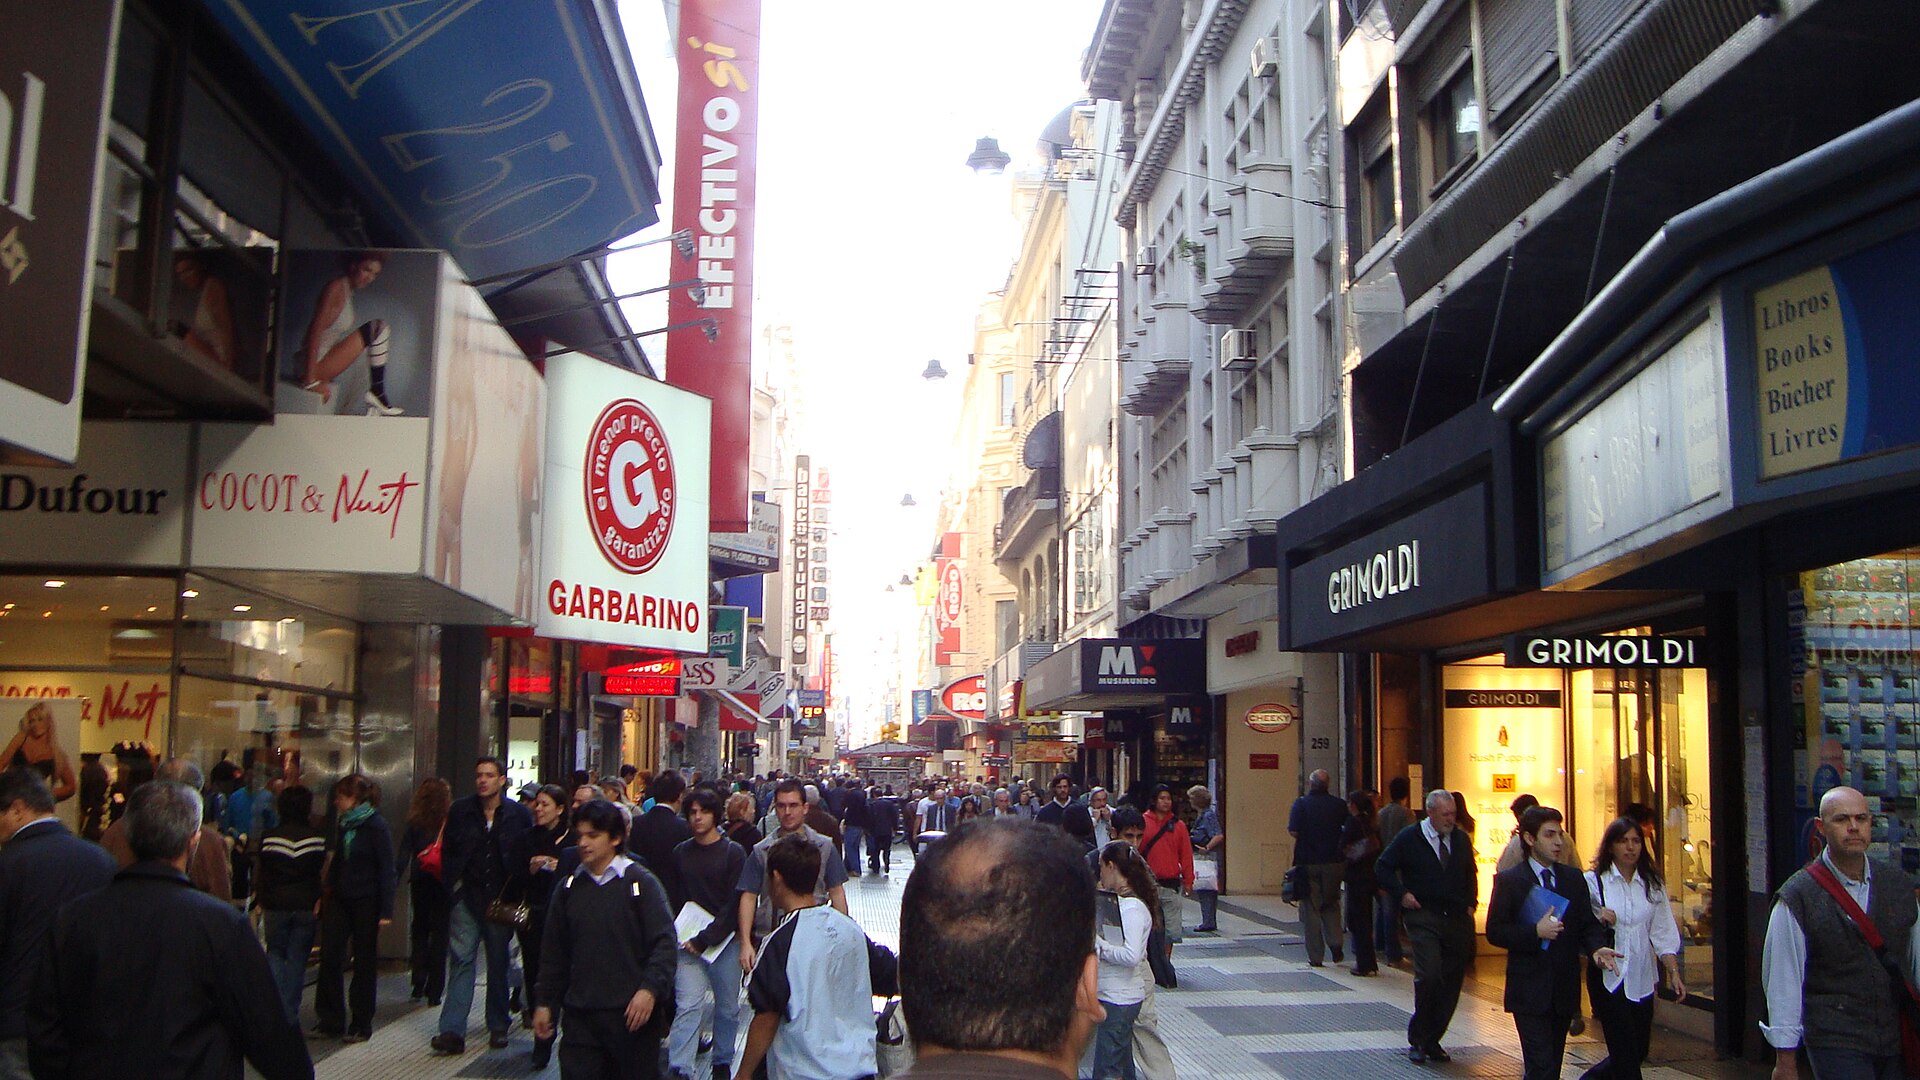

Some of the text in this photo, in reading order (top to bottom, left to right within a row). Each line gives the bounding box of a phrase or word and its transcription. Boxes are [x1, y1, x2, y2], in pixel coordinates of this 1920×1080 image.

[697, 96, 741, 309] EFECTIVO
[1762, 290, 1830, 331] Libros
[1765, 334, 1833, 373] Books
[1767, 378, 1836, 415] Bücher
[1769, 423, 1838, 458] Livres
[593, 414, 667, 511] el menor precio
[0, 472, 167, 516] Dufour
[200, 469, 420, 539] COCOT & Nuit
[608, 439, 661, 529] G
[604, 487, 673, 560] garantizado
[794, 545, 808, 630] ciudad
[1327, 539, 1422, 615] GRIMOLDI
[548, 579, 700, 634] GARBARINO
[1526, 638, 1695, 666] GRIMOLDI
[1098, 677, 1157, 685] MUSIMUNDO
[1468, 693, 1540, 706] GRIMOLDI
[1249, 714, 1290, 722] CHEEKY
[1311, 738, 1329, 750] 259
[1469, 753, 1495, 762] Hush
[1495, 778, 1512, 790] CAT
